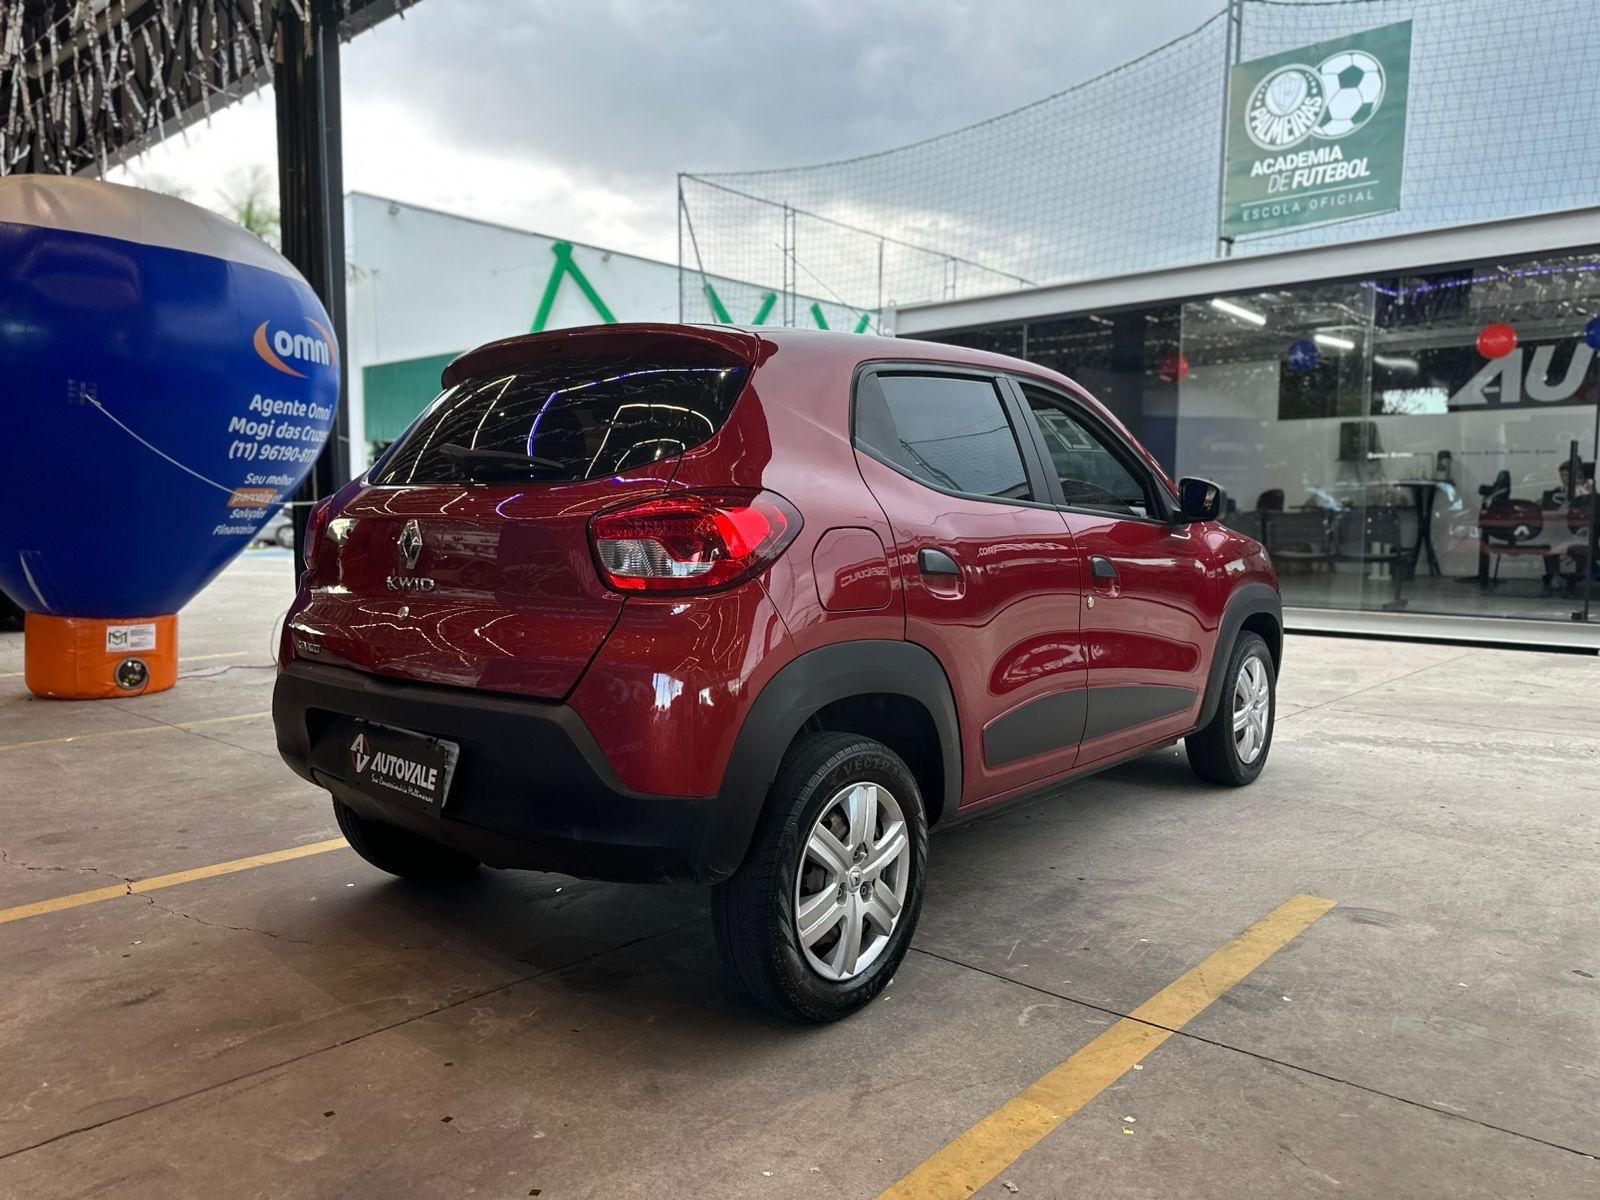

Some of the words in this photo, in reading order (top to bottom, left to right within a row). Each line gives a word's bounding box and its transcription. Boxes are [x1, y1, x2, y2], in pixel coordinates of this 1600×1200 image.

[1250, 96, 1323, 145] PALMEIRAS
[1251, 145, 1343, 177] ACADEMIA
[1267, 171, 1292, 194] DE
[1291, 157, 1371, 190] FUTEBOL
[1242, 202, 1300, 222] ESCOLA
[1308, 189, 1375, 210] OFICIAL
[249, 393, 307, 417] Agente
[308, 402, 332, 420] Omni
[228, 416, 275, 441] Mogi
[275, 421, 301, 439] das
[229, 440, 258, 461] (11)
[244, 472, 266, 485] Seu
[386, 575, 435, 591] KWID
[370, 751, 438, 791] AUTOVALE
